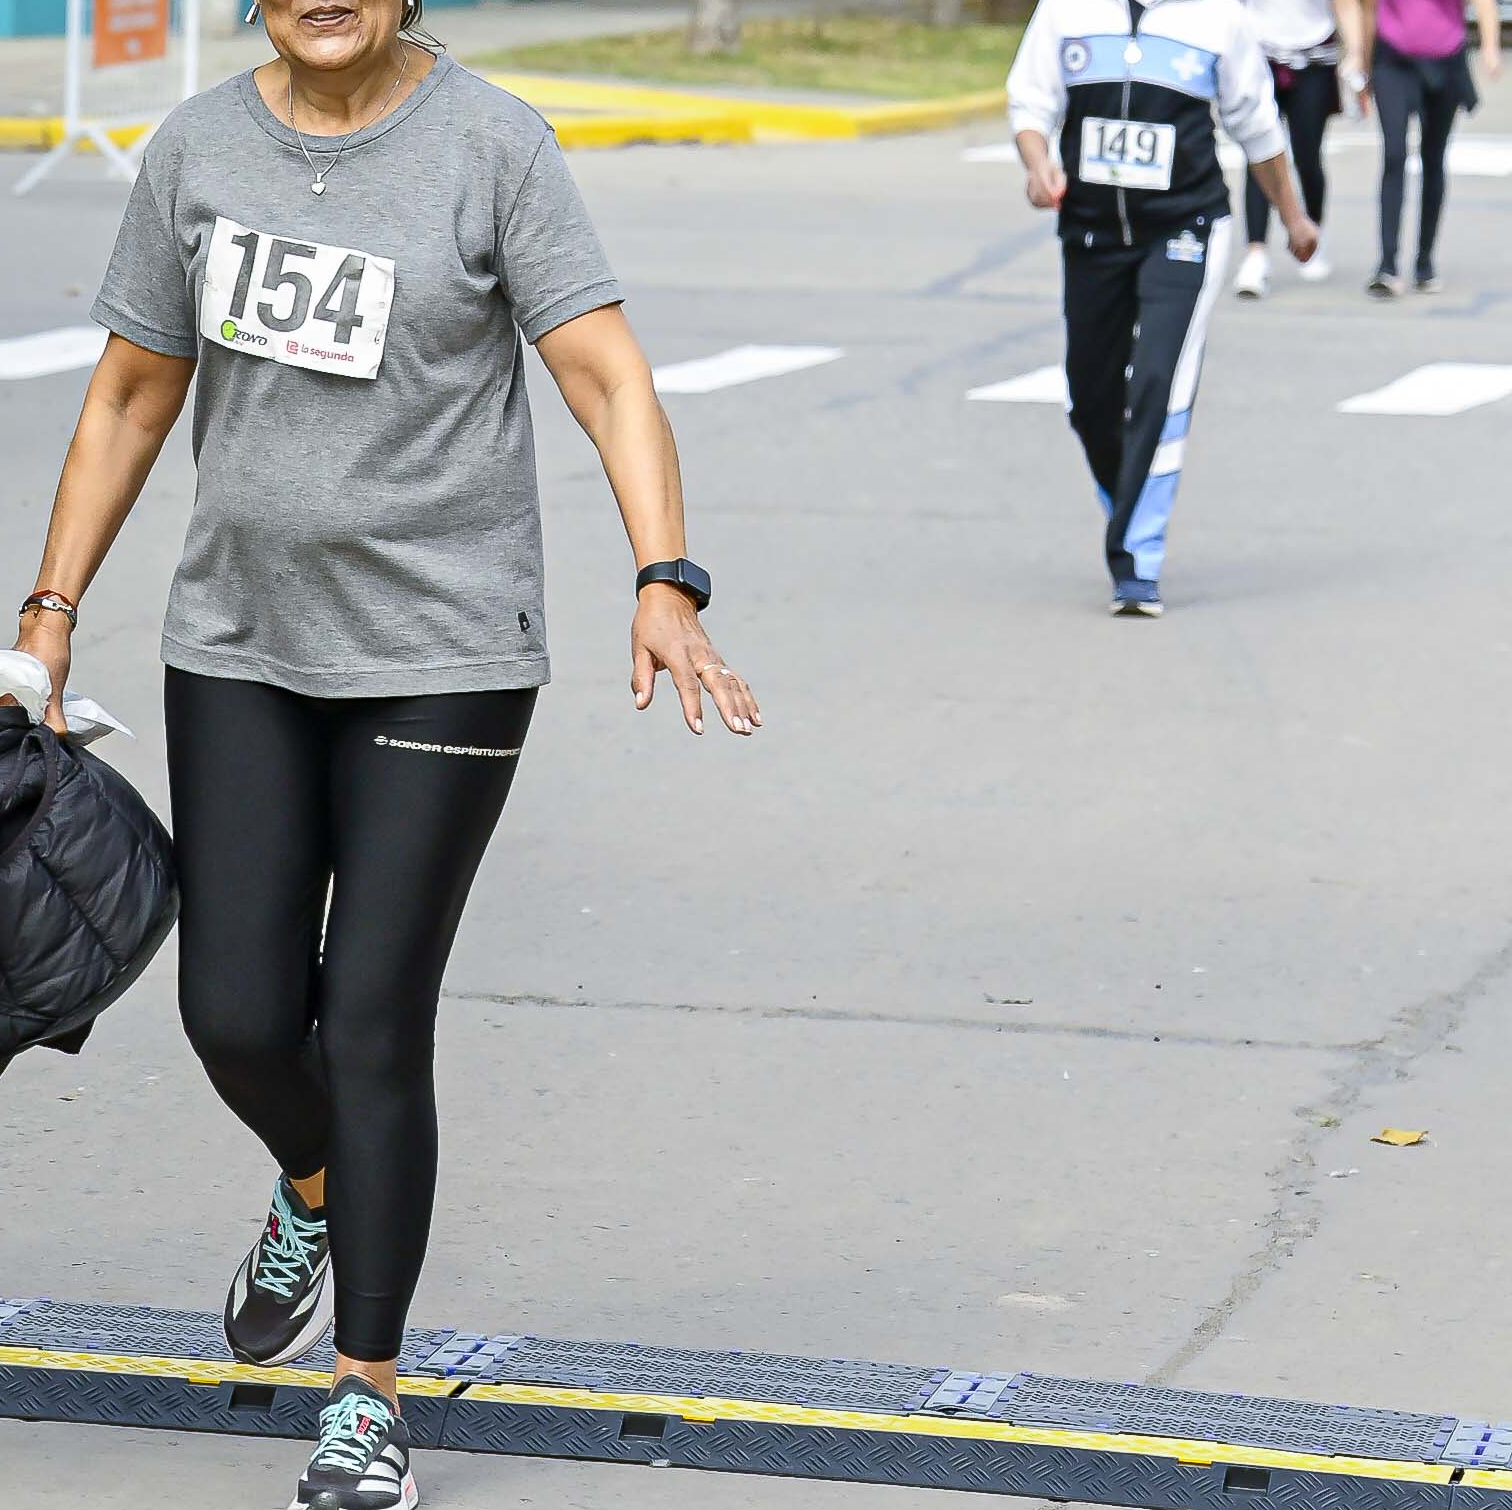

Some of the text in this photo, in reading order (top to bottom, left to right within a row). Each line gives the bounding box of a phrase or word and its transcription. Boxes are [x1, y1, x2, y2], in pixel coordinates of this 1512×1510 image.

[1096, 125, 1157, 166] 149
[229, 232, 366, 344] 154
[310, 348, 354, 362] segunda
